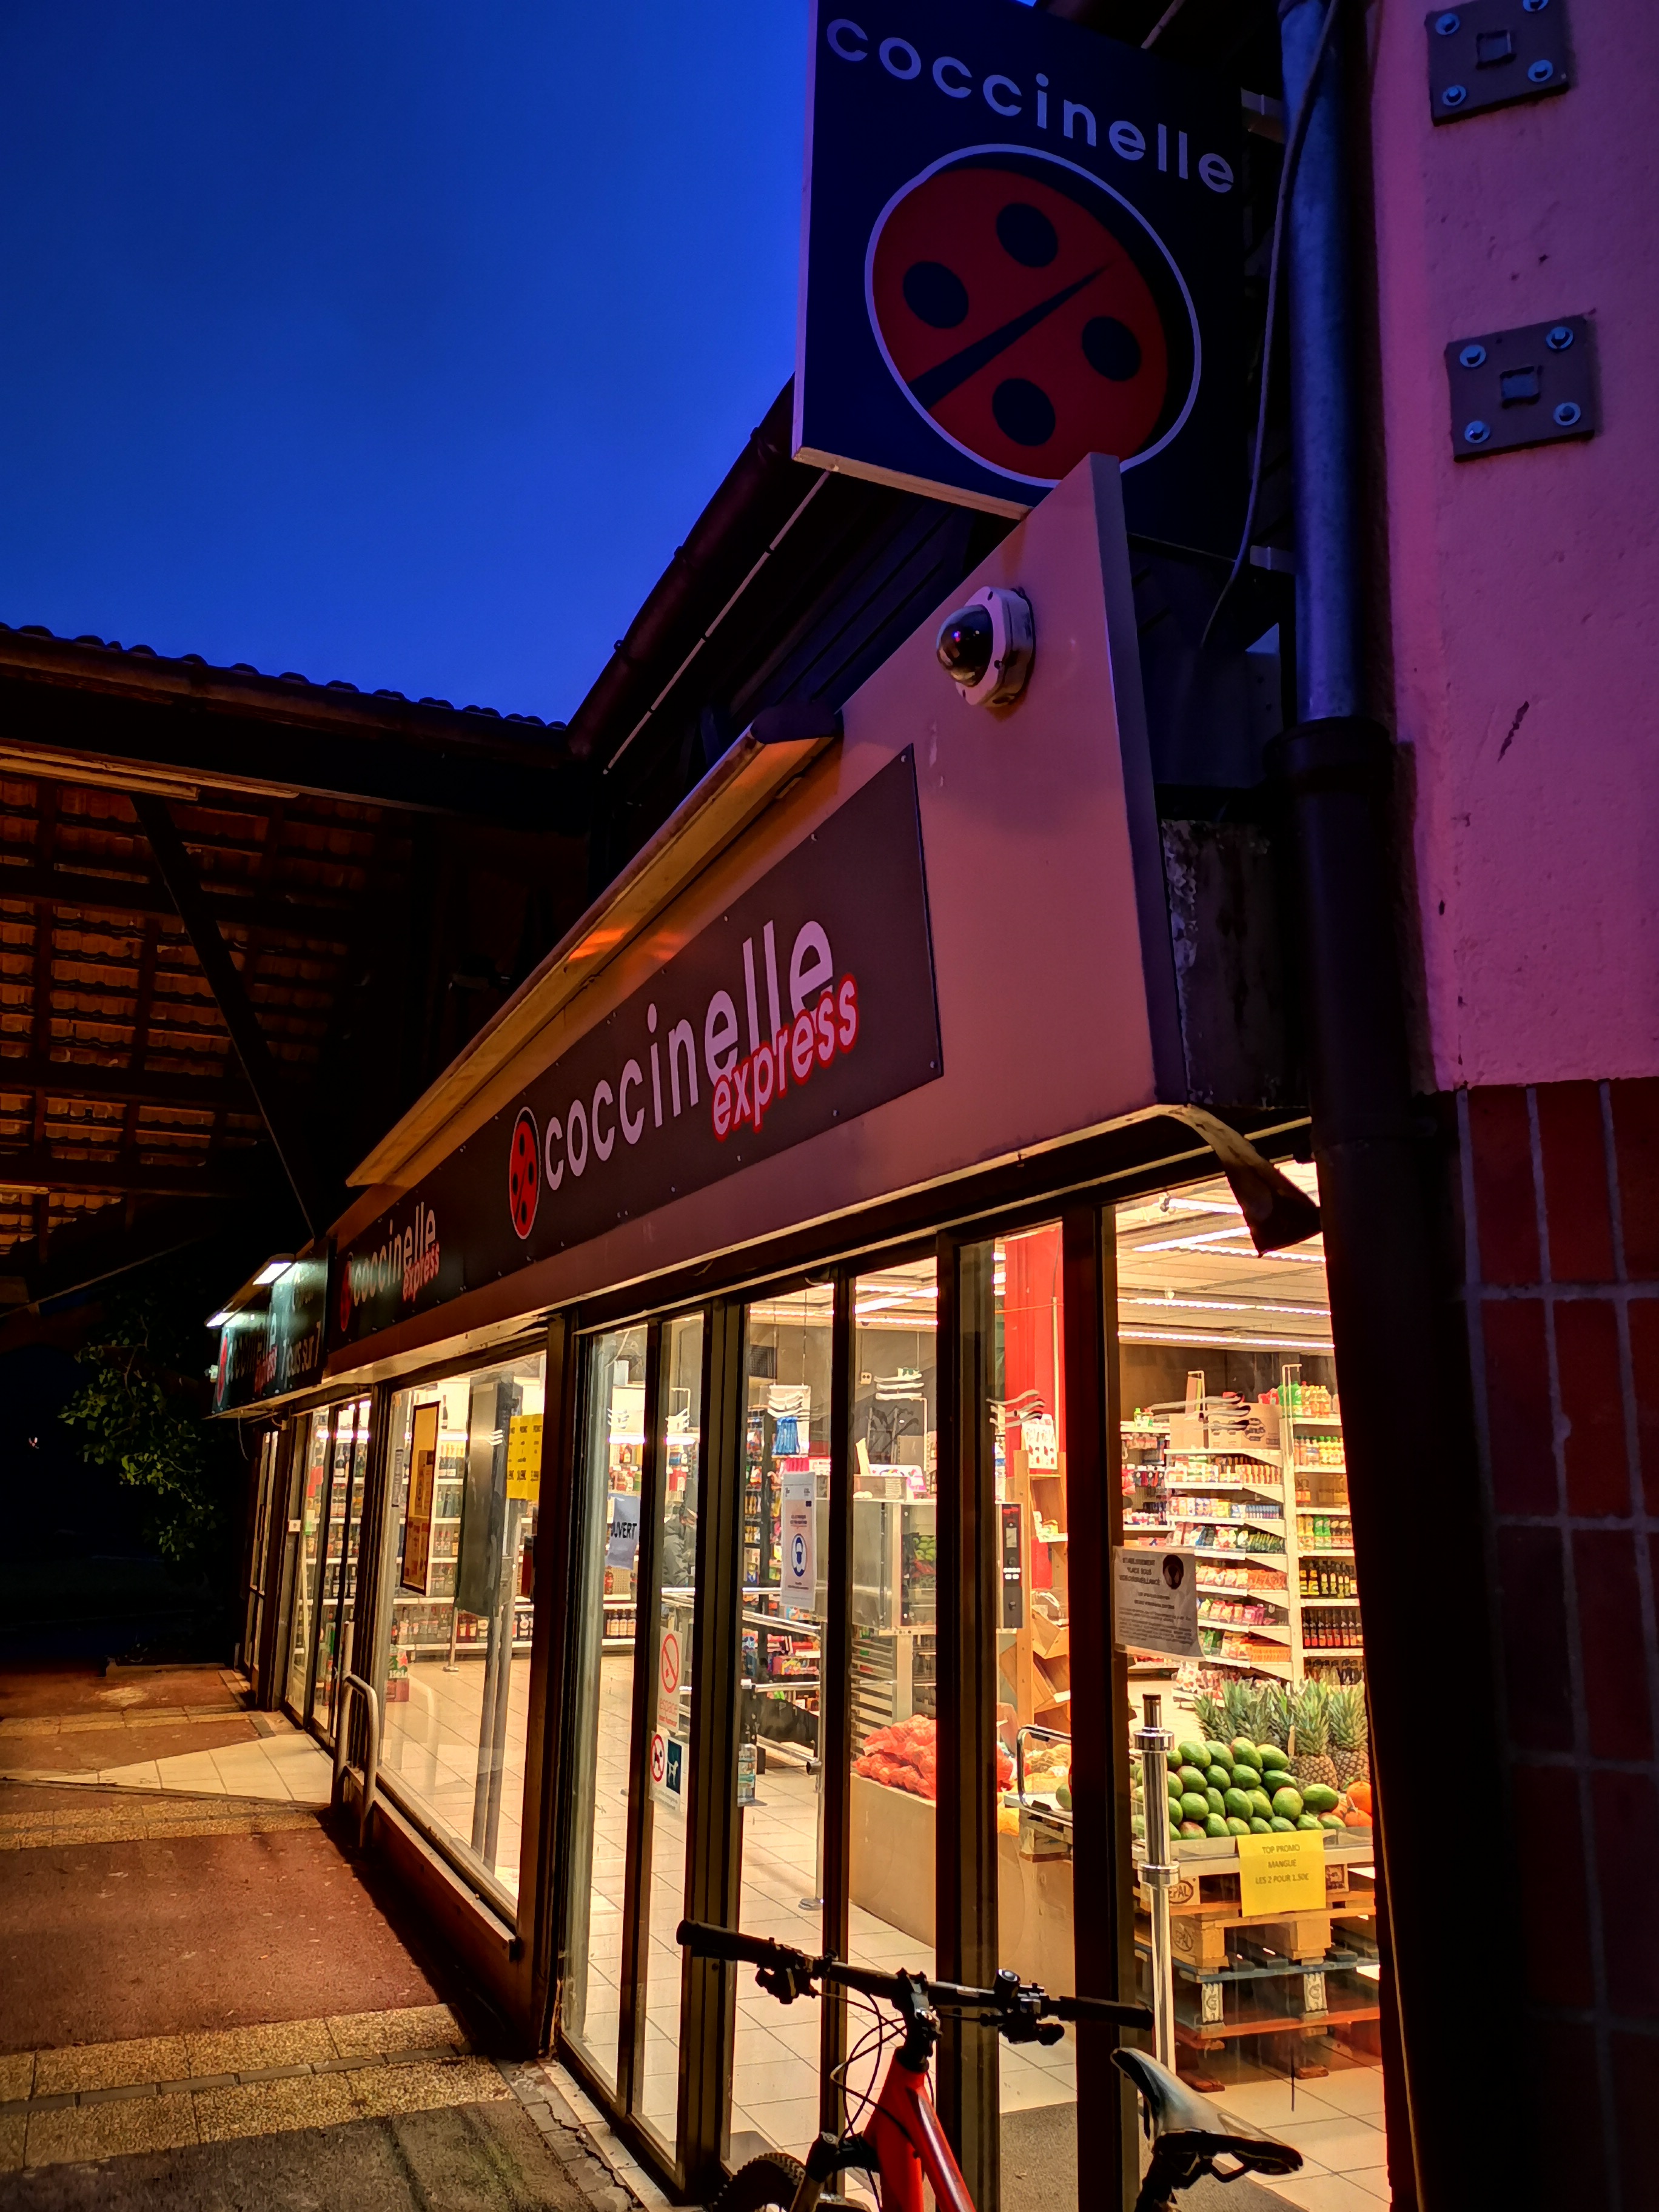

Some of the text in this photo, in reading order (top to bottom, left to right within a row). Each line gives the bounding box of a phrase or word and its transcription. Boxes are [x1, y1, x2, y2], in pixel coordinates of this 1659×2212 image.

[826, 18, 1234, 193] coccinelle
[545, 919, 834, 1190] coccinelle
[712, 979, 858, 1136] express
[354, 1201, 436, 1307] coccinelle
[403, 1241, 440, 1302] express
[610, 1521, 637, 1540] UVERT
[1255, 1875, 1267, 1885] LES
[1267, 1875, 1272, 1884] 2
[1273, 1874, 1291, 1883] POUR
[1262, 1844, 1301, 1854] TOP PROMO
[1267, 1858, 1297, 1869] MANGUE
